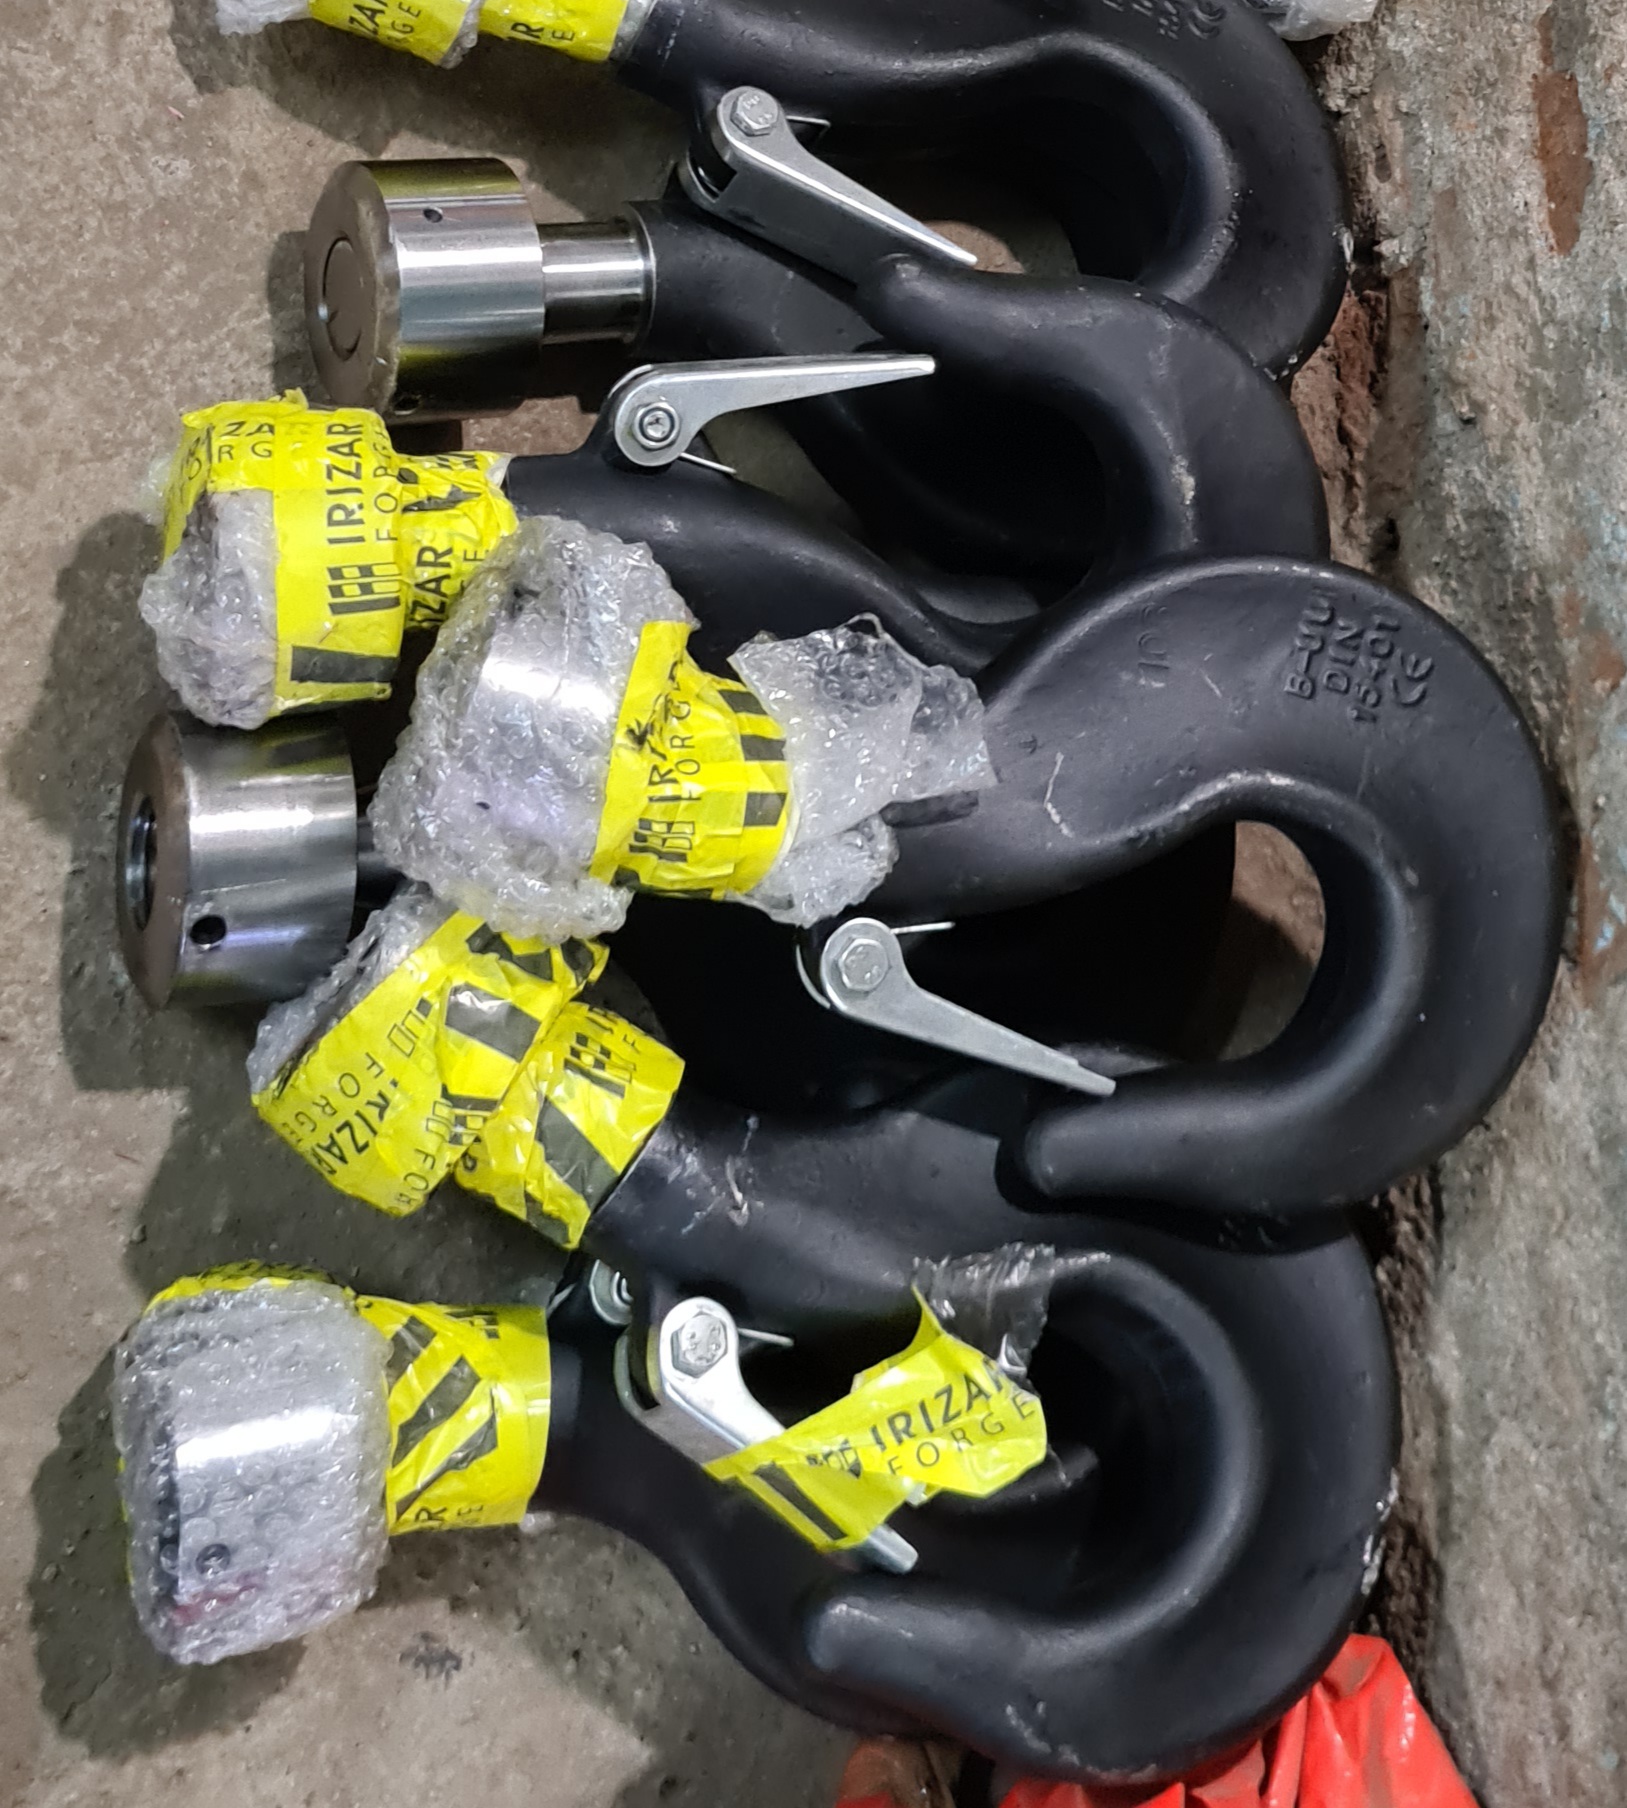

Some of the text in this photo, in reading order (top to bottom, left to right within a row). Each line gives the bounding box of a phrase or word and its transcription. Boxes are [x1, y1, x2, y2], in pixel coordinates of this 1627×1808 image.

[325, 422, 367, 546] IRIZAR
[1323, 617, 1364, 695] DIN
[887, 1391, 1037, 1477] FORGE
